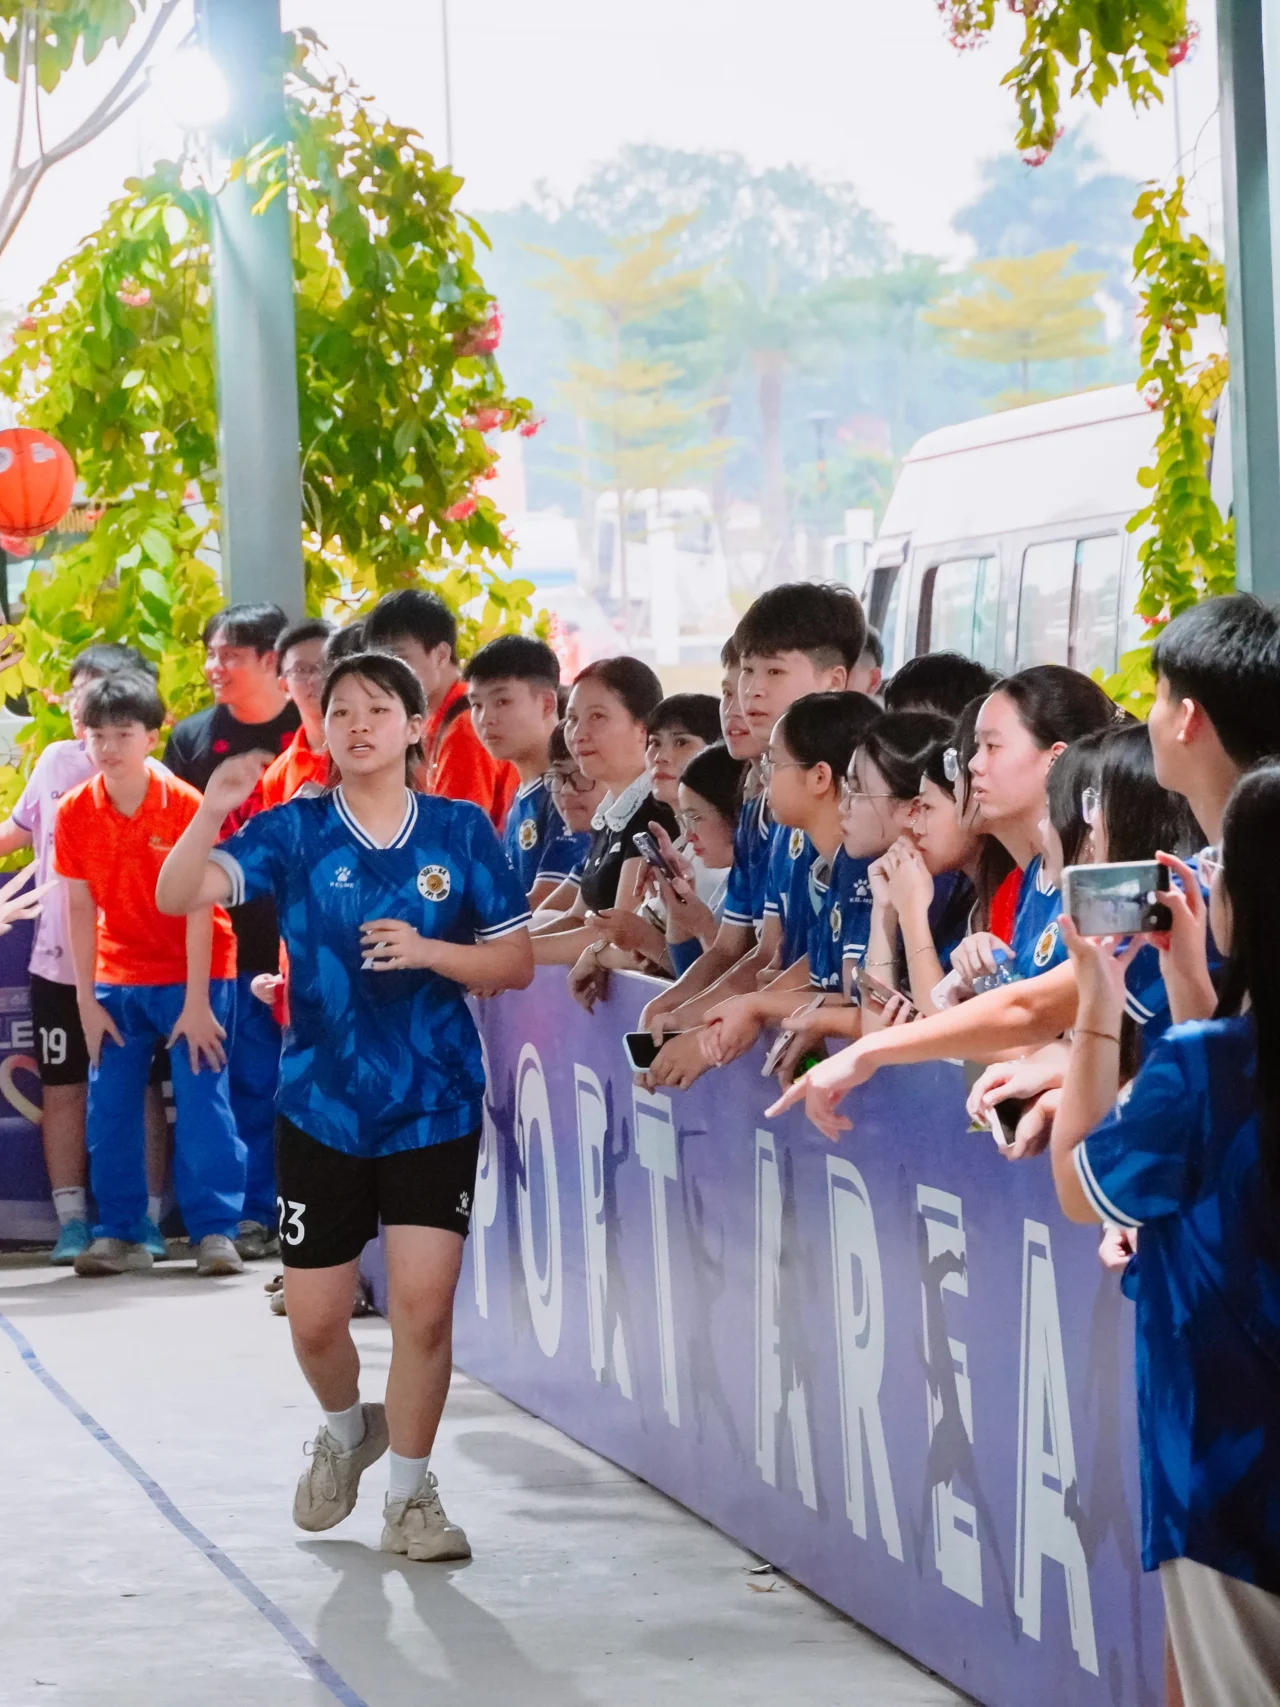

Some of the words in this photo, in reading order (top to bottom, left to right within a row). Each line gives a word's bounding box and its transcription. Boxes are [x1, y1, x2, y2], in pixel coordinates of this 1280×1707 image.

[39, 1027, 67, 1065] 19
[276, 1196, 306, 1246] 23
[472, 1042, 680, 1428] PORT
[755, 1126, 1100, 1678] AREA
